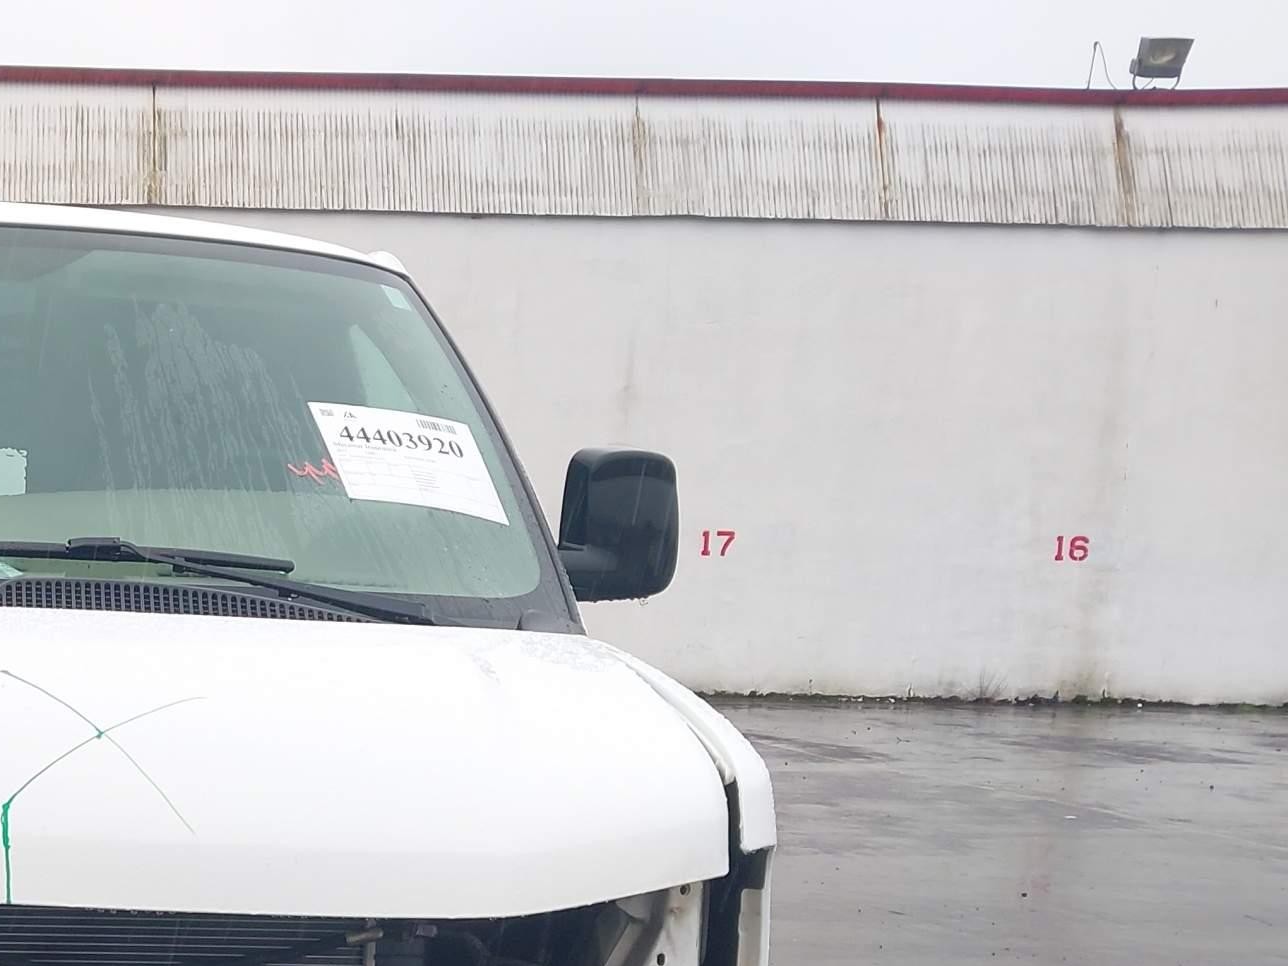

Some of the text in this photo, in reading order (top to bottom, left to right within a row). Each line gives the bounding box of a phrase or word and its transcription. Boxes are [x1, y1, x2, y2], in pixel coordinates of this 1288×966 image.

[339, 425, 464, 459] 44403920
[699, 530, 736, 557] 17
[1054, 535, 1090, 562] 16
